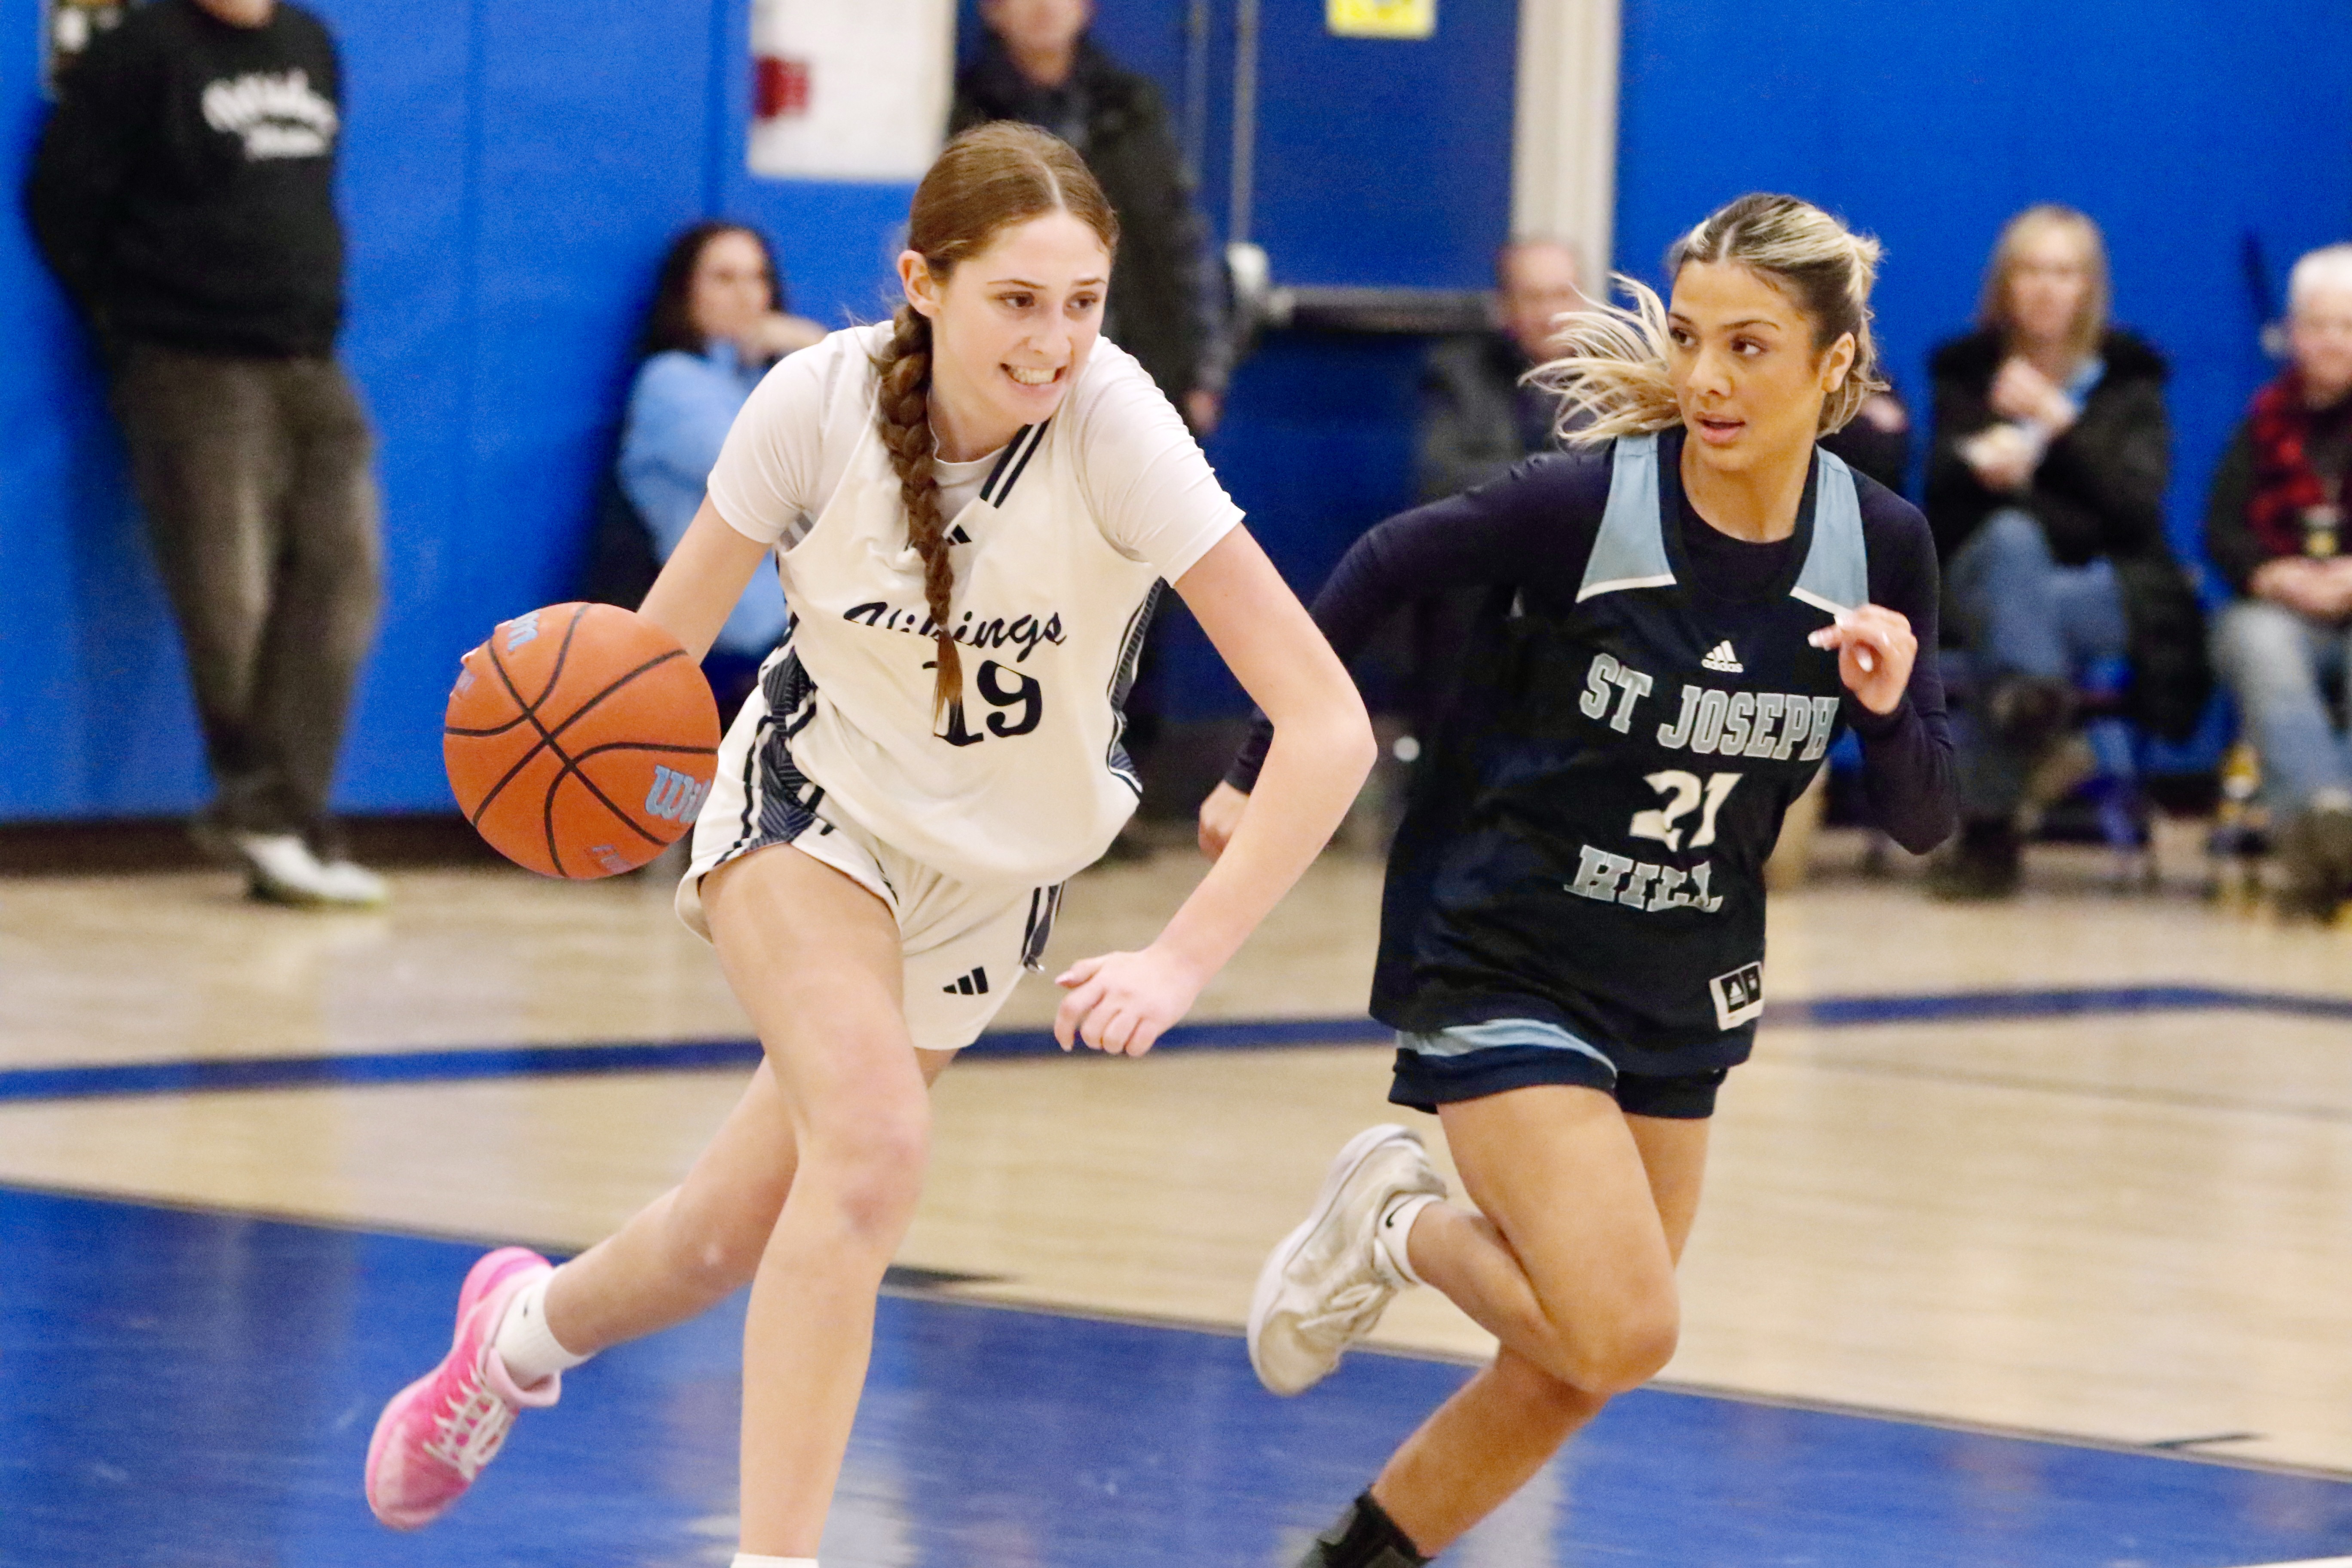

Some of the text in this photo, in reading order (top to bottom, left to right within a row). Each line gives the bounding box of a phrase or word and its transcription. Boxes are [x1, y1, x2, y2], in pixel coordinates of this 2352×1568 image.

[922, 660, 1042, 747] 19
[1580, 653, 1840, 761] ST JOSEPH
[1701, 658, 1744, 673] adidas
[1629, 769, 1744, 852] 21
[1563, 845, 1723, 913] HILL
